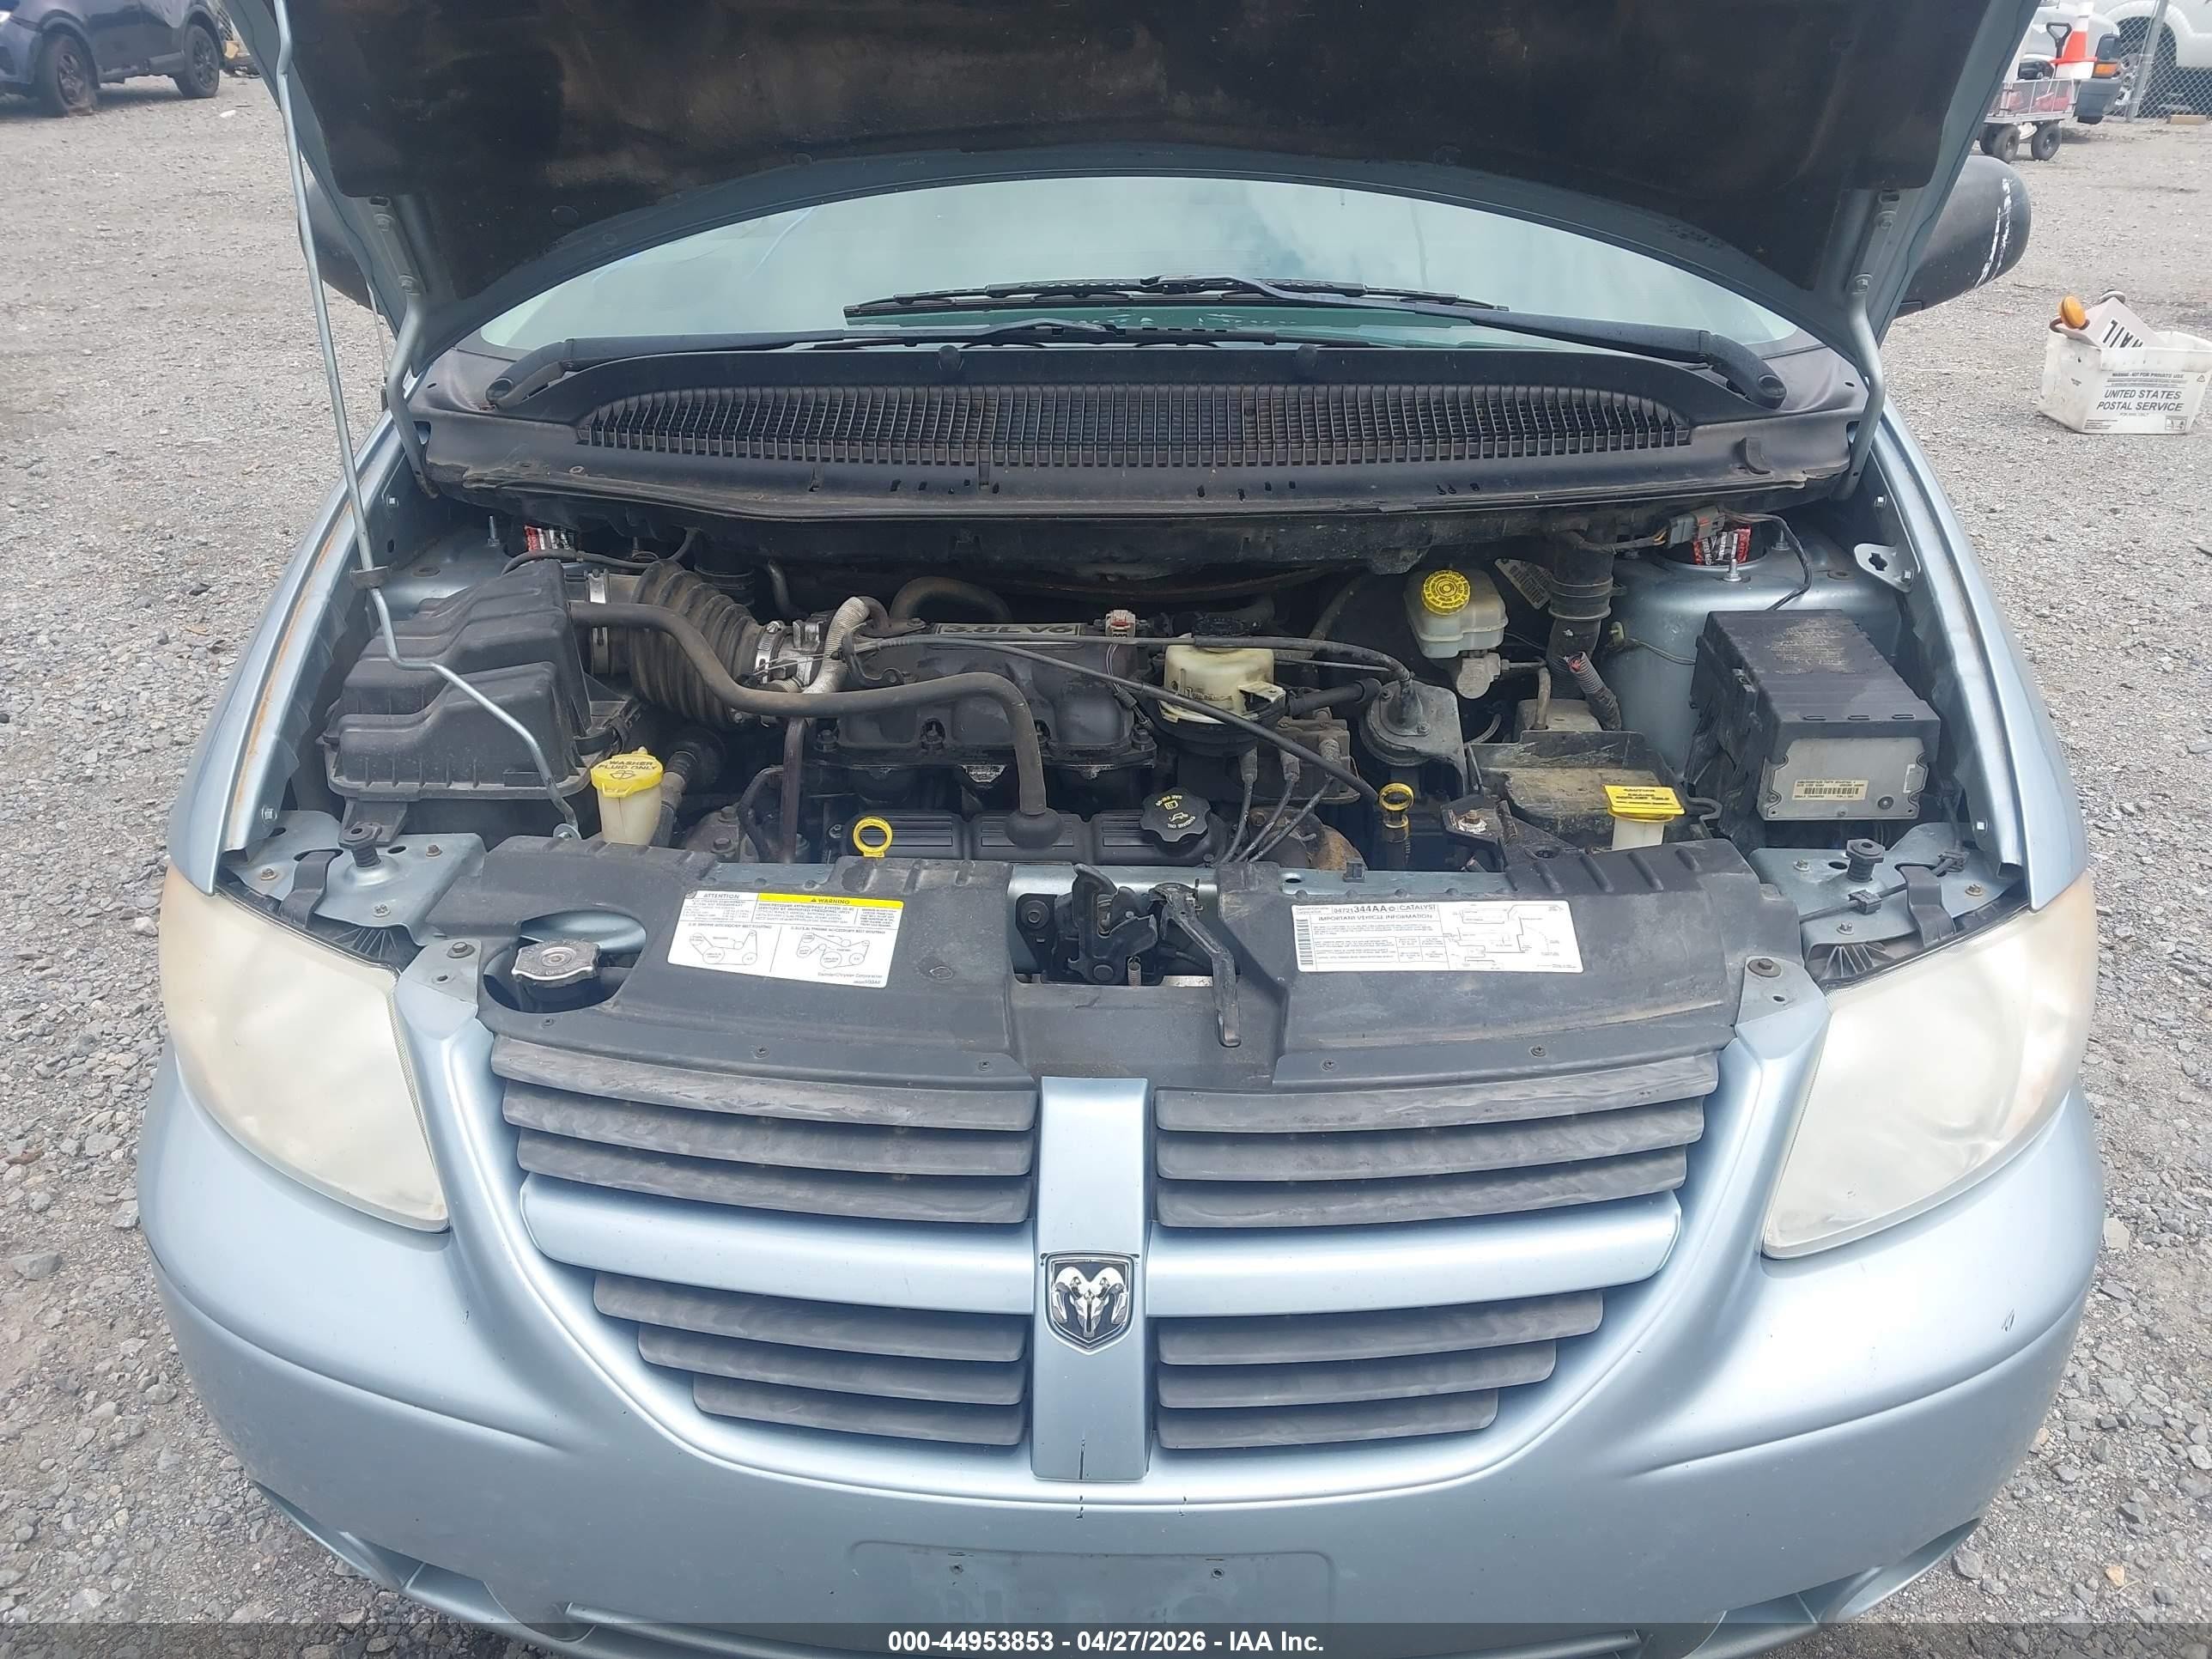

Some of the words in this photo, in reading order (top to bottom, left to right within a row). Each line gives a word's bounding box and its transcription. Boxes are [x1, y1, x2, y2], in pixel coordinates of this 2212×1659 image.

[2104, 390, 2136, 398] UNITED
[2138, 390, 2182, 400] STATES
[2096, 401, 2132, 410] POSTAL
[2136, 402, 2185, 412] SERVICE
[1027, 625, 1073, 634] V6
